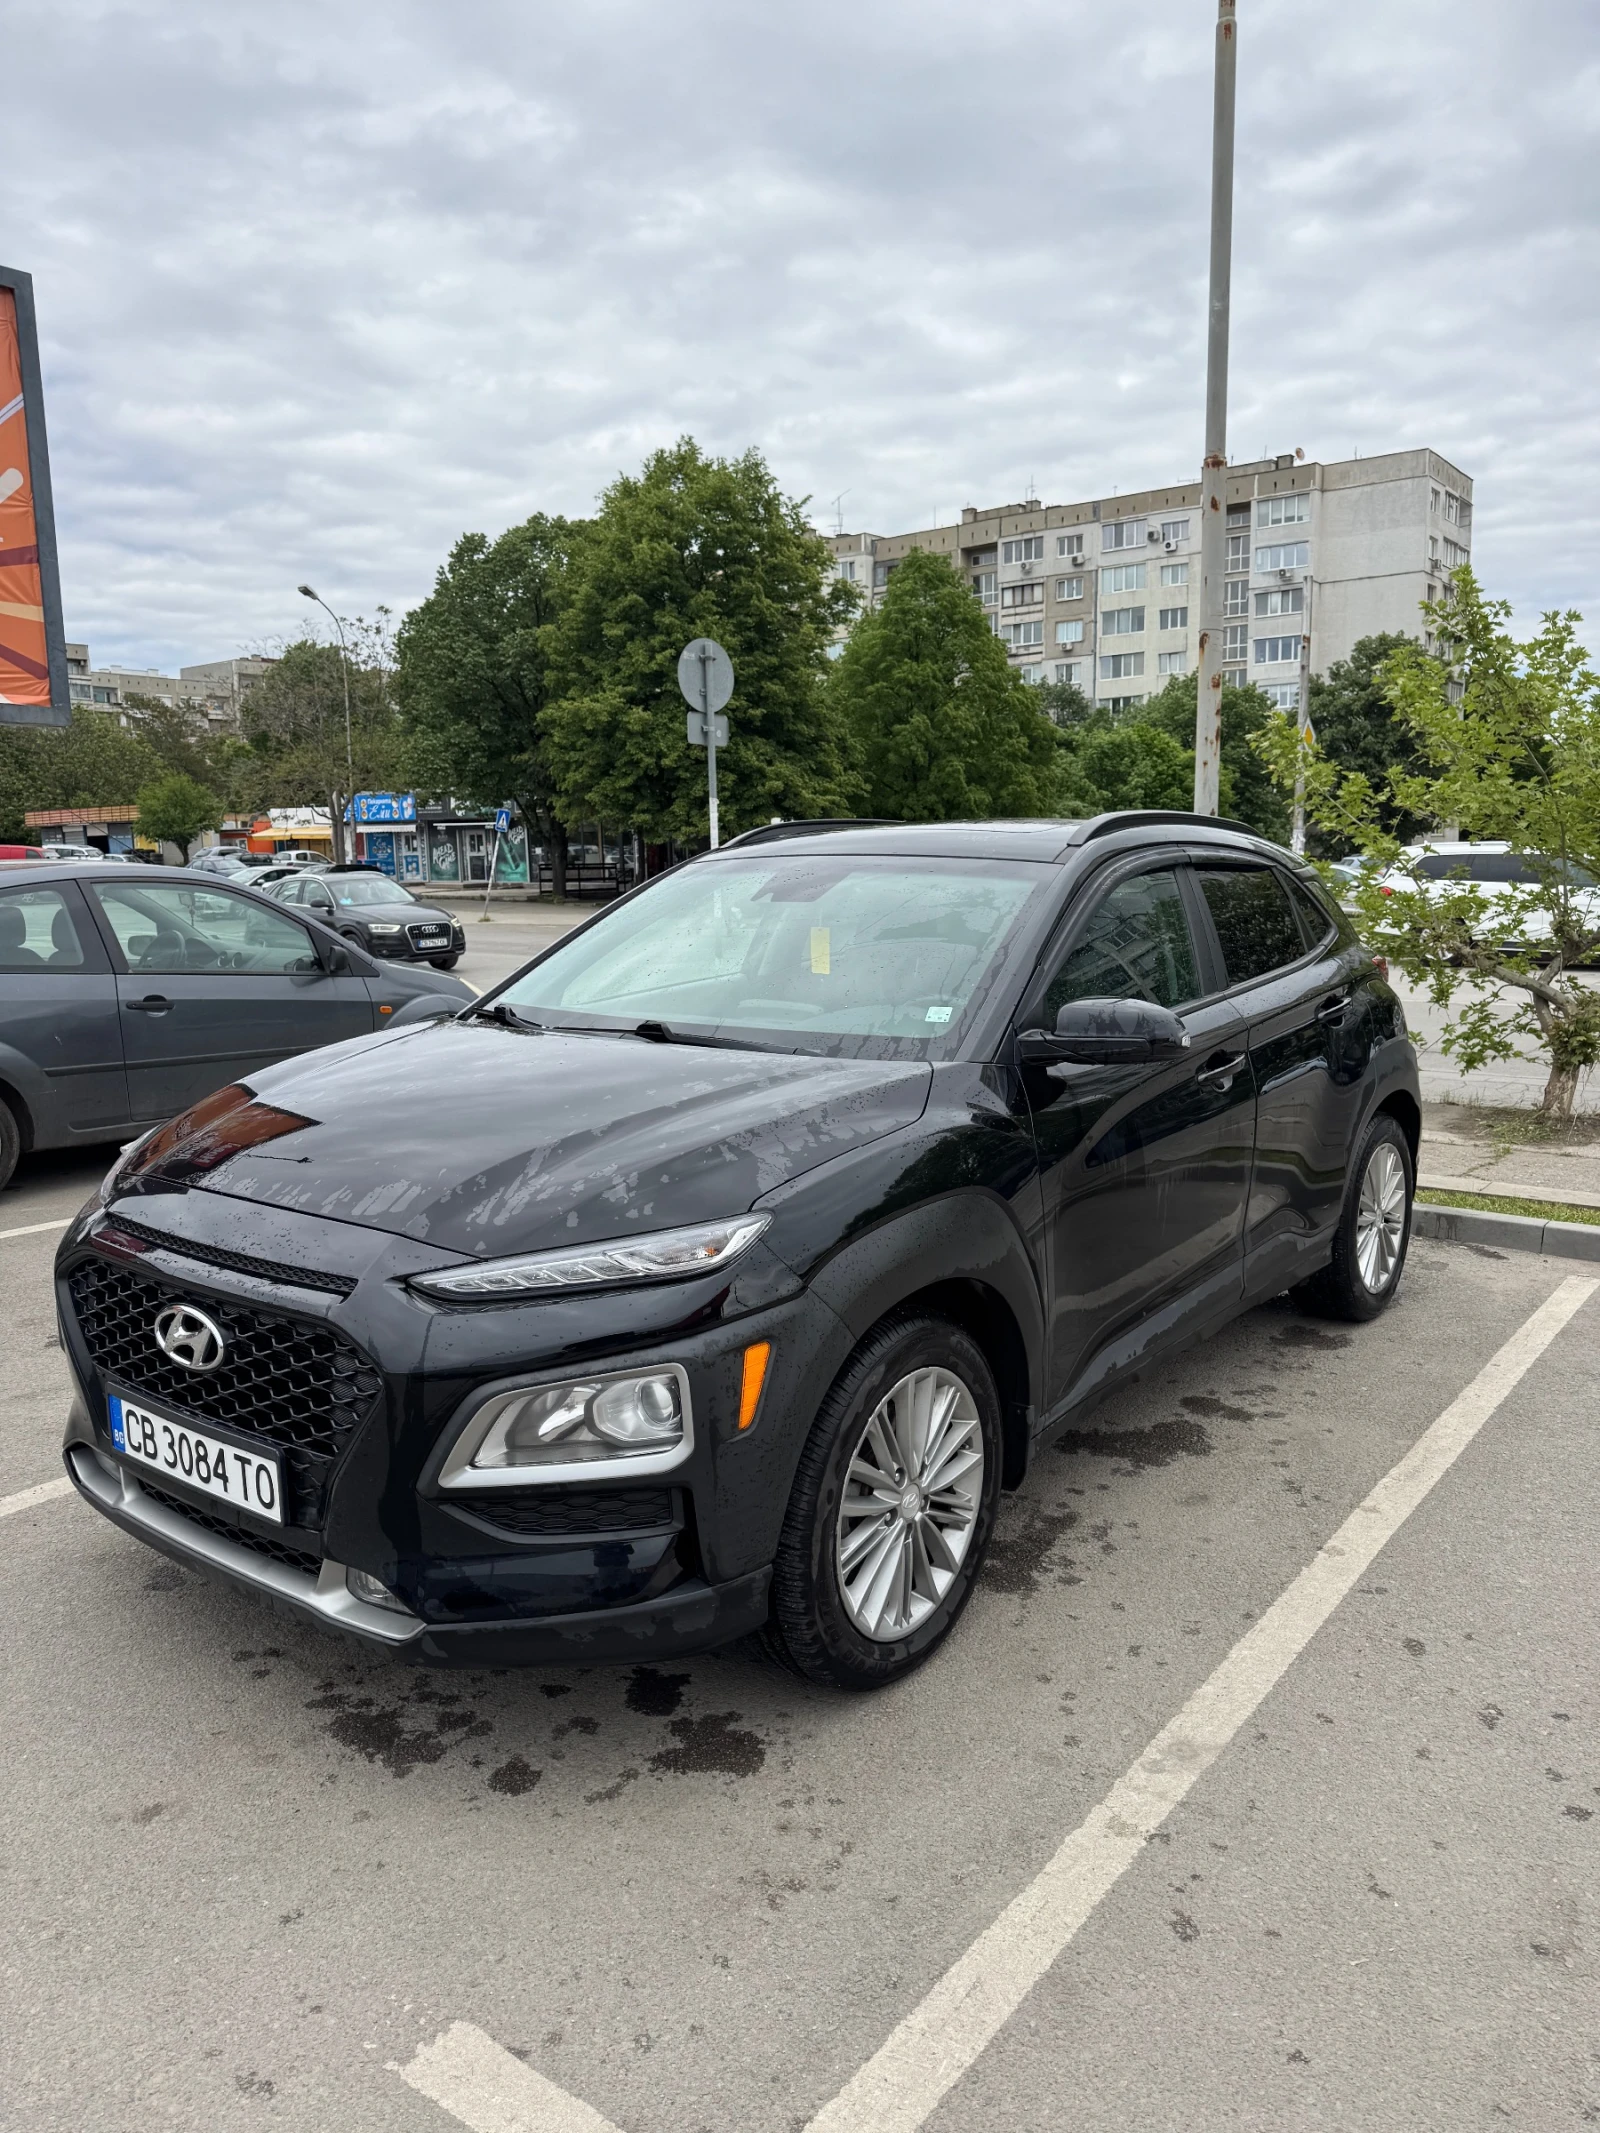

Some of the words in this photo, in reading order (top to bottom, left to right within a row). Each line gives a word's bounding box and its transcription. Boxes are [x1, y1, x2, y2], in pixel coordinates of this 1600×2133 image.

[114, 1429, 124, 1444] BG
[126, 1409, 157, 1460] CB
[163, 1425, 229, 1493] 3084
[234, 1453, 275, 1510] TO
